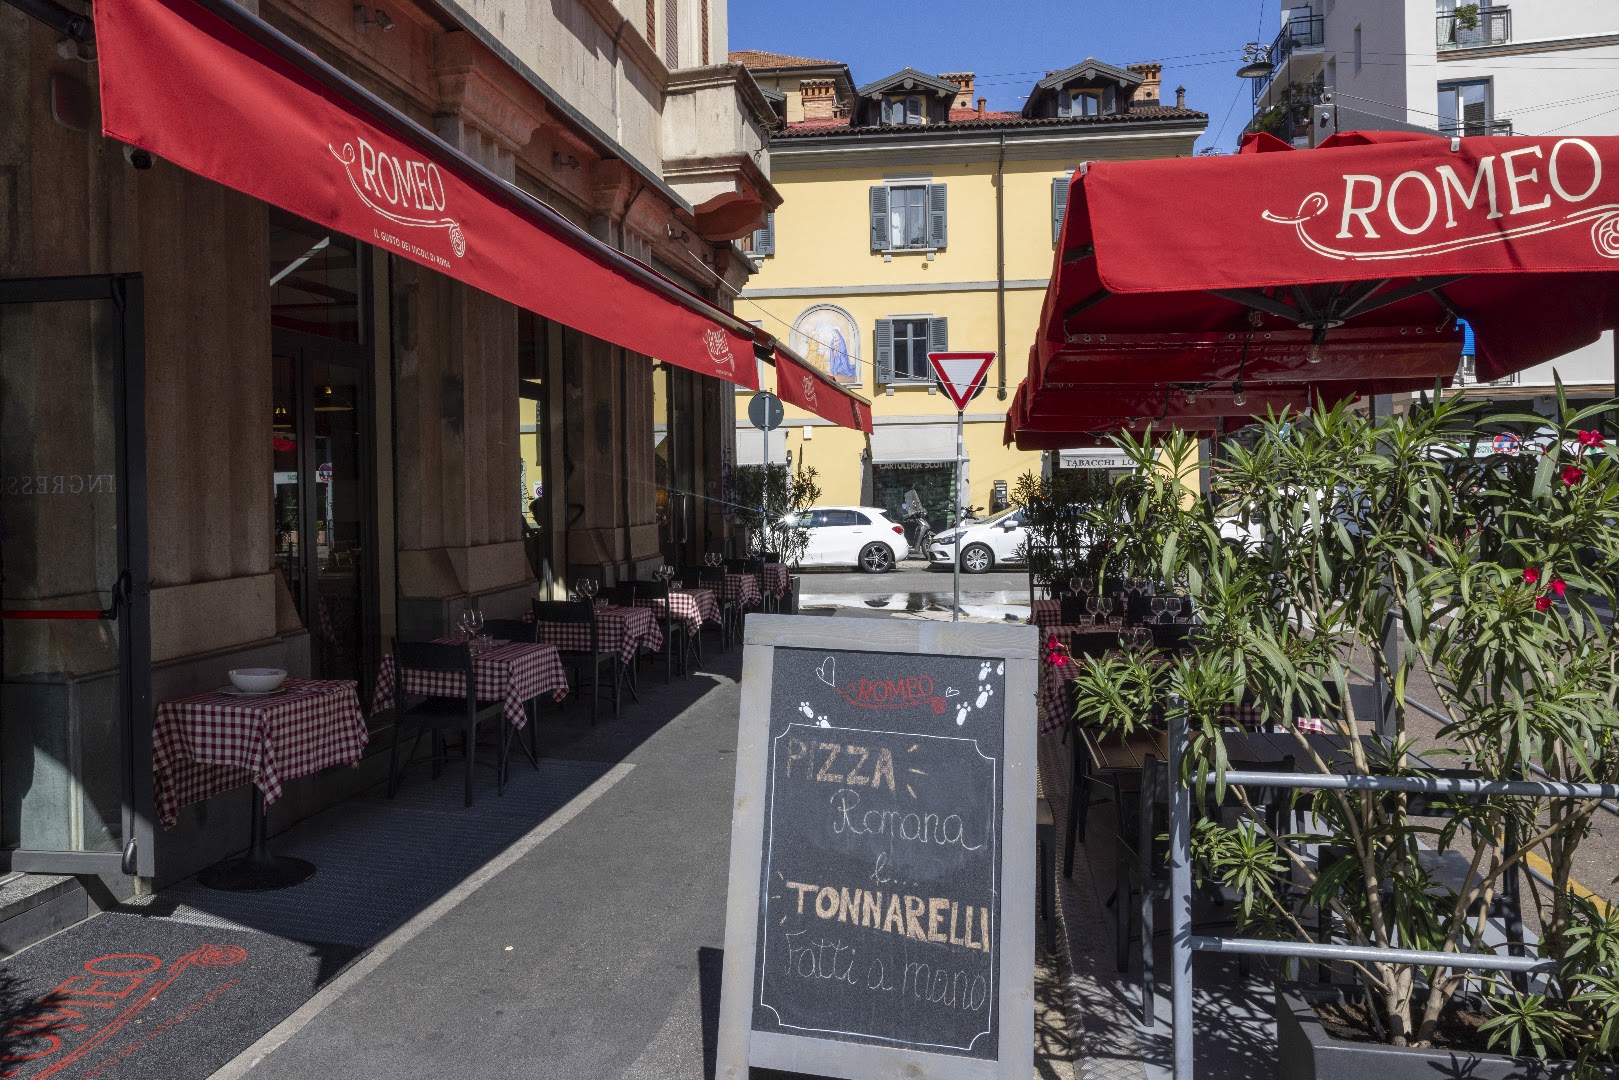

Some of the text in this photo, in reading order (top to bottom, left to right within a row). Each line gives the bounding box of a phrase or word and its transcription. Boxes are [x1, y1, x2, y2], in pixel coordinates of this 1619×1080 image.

[357, 136, 446, 212] ROMEO
[1335, 138, 1602, 239] ROMEO
[380, 231, 400, 247] GUSTO
[878, 462, 923, 470] CARTOLERIA
[1066, 459, 1115, 467] TABACCHI
[857, 675, 934, 703] ROMEO
[786, 737, 896, 791] PIZZA
[830, 788, 982, 851] Romana
[786, 881, 990, 953] TONNARELLI
[902, 961, 987, 1011] mano
